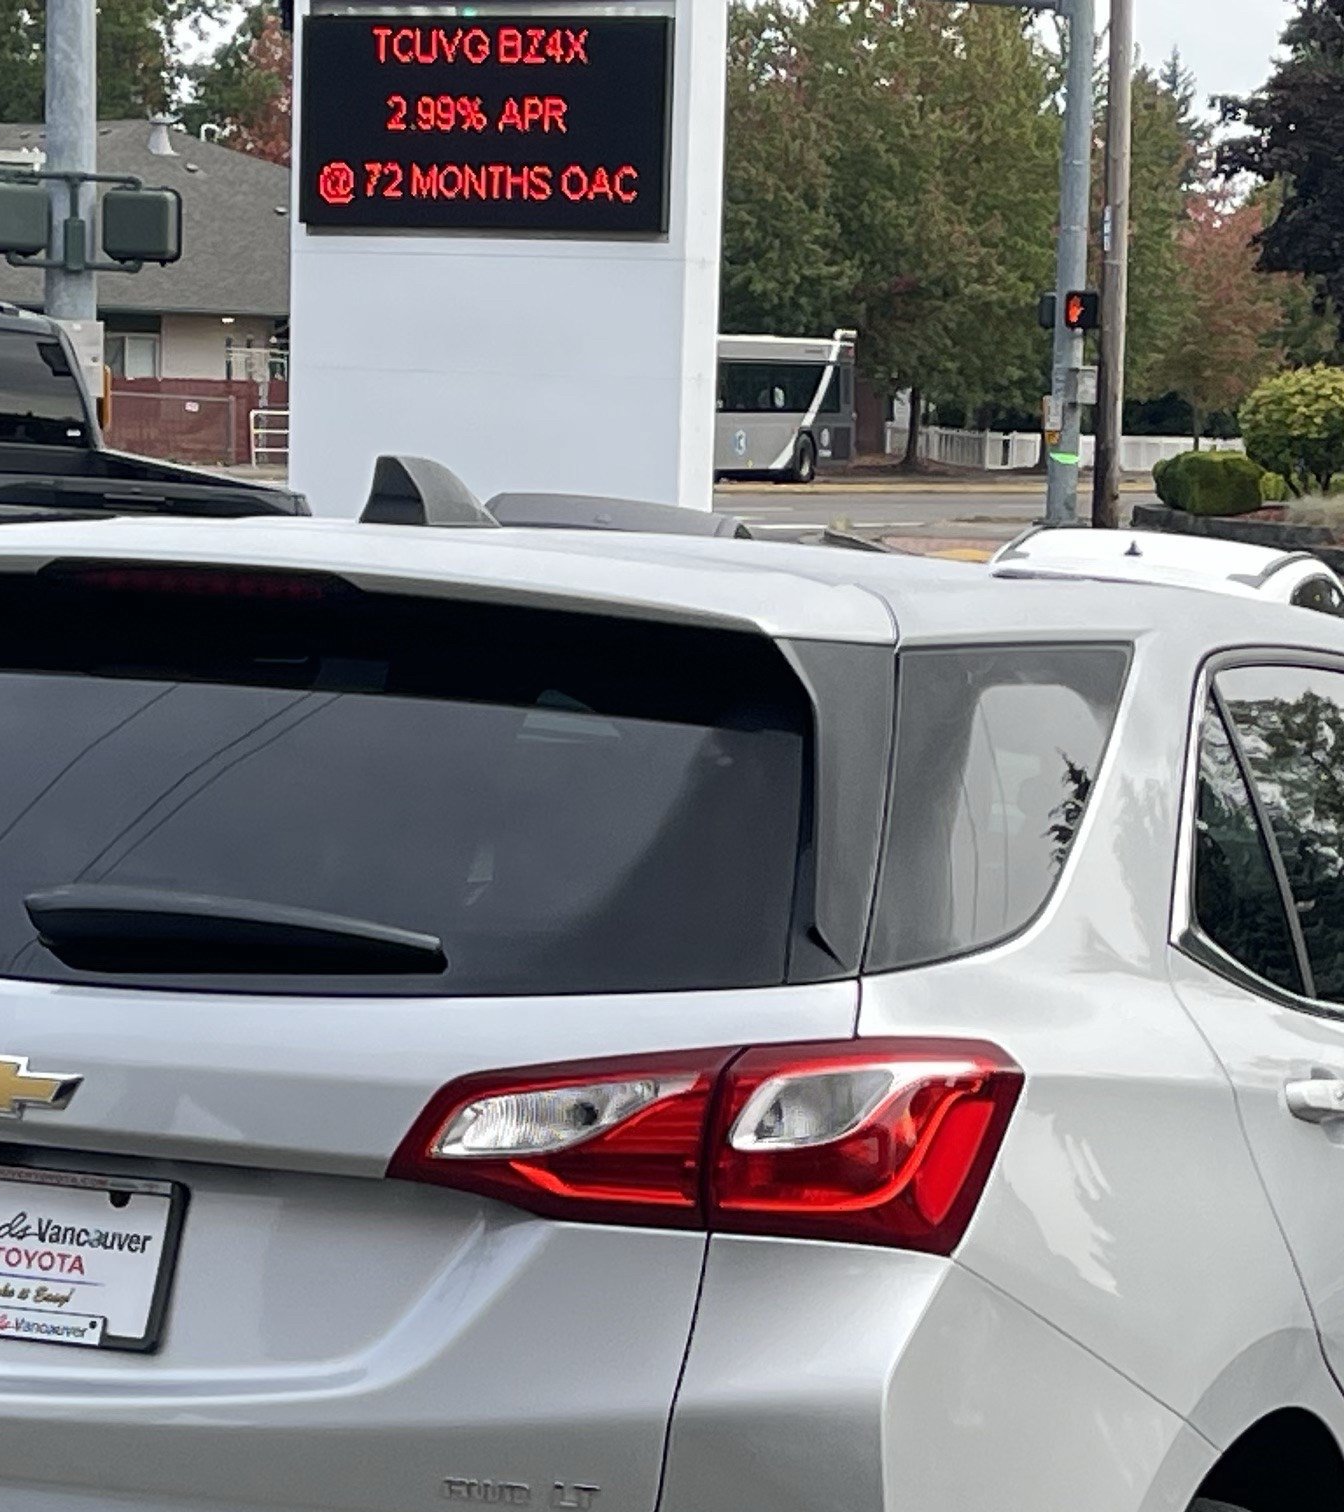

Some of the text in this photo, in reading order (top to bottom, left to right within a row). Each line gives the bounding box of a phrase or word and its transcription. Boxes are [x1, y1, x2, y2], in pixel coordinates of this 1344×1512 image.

[372, 28, 589, 65] TCUVG BZ4X
[386, 95, 568, 133] 2.99% APR
[319, 162, 638, 205] @ 72 MONTHS OAC
